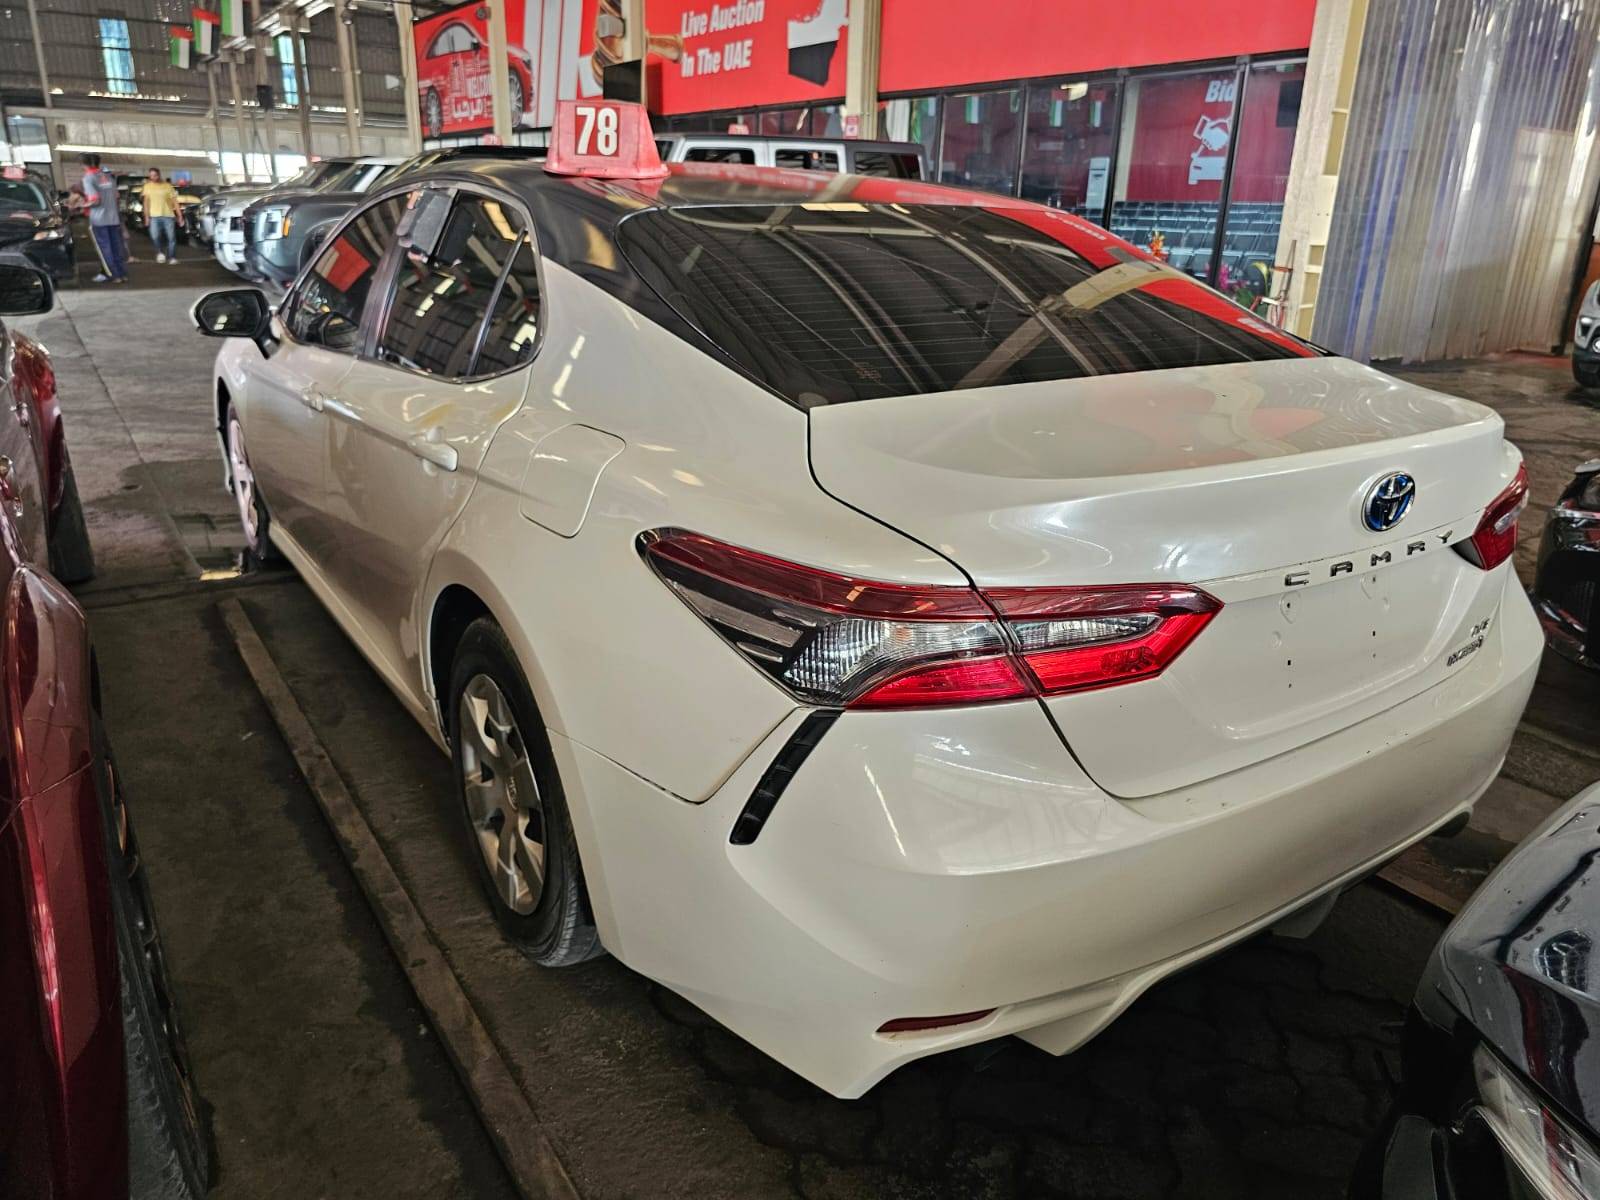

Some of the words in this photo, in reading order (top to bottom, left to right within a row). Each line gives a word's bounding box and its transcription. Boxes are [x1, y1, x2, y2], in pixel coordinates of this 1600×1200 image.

[681, 10, 708, 39] Live
[709, 0, 765, 33] Auction
[681, 51, 695, 78] In
[697, 47, 721, 76] The
[723, 39, 753, 71] UAE
[576, 107, 618, 156] 78
[1284, 530, 1453, 587] CAMRY
